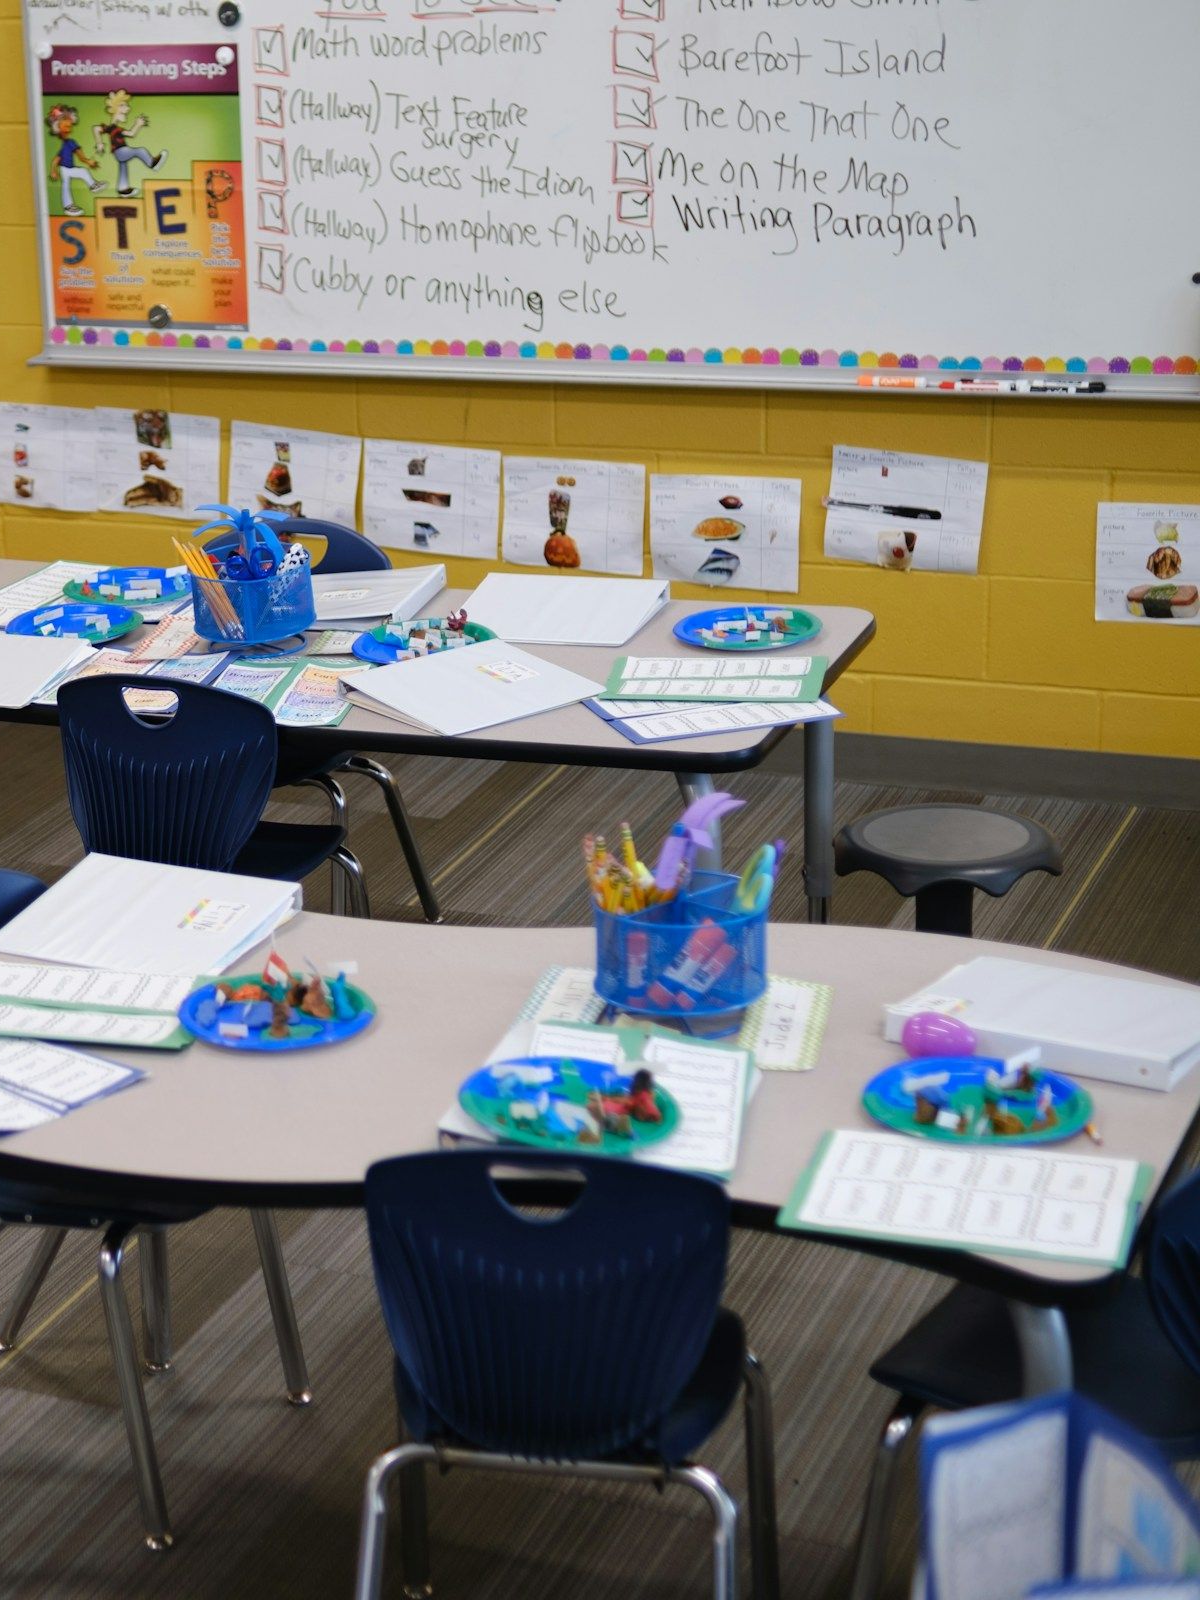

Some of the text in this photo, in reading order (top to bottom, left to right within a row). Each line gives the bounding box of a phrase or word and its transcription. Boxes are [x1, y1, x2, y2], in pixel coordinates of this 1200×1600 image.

[51, 58, 228, 80] Problem-Solving Steps
[293, 20, 548, 66] Math word problems
[679, 31, 947, 78] Barefoot Island
[287, 80, 529, 134] (Hallway) Text Feature
[676, 95, 962, 150] The One That One
[292, 143, 595, 204] (Hallway) Guess the Idiom
[657, 146, 910, 200] Me on the Map
[290, 199, 388, 254] (Hallway)
[672, 194, 978, 257] Writing Paragraph
[292, 256, 628, 332] Cubby or anything else
